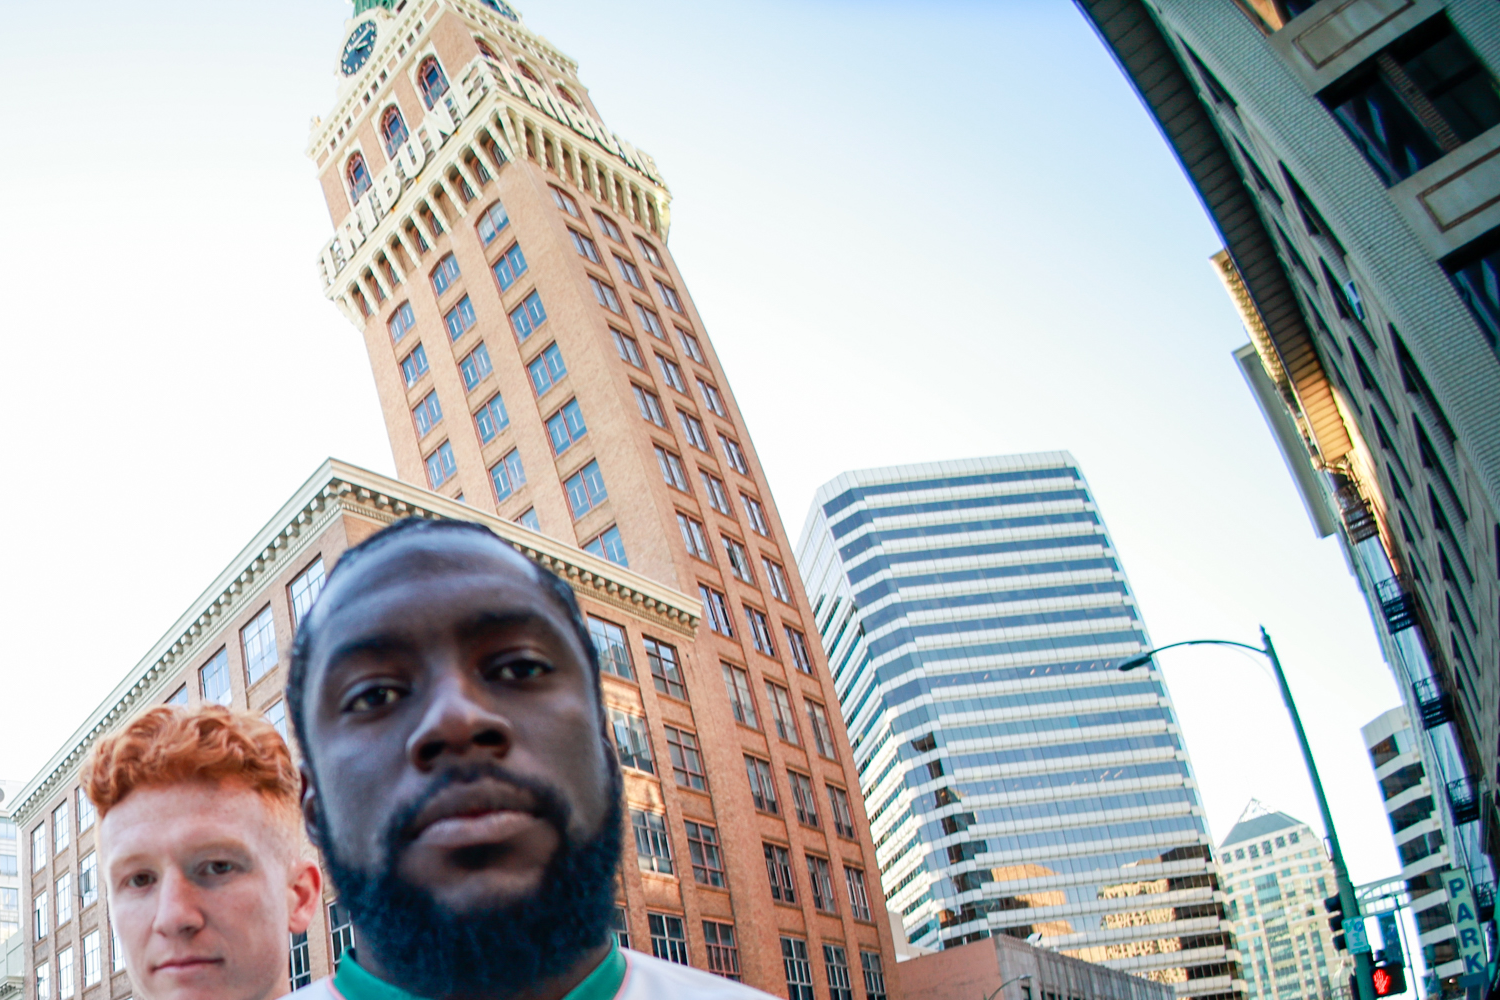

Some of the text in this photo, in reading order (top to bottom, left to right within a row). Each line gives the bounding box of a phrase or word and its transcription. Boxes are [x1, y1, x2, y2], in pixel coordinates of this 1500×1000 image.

[317, 56, 492, 279] TRIBUNE
[485, 57, 666, 188] TRIBUNE
[1448, 877, 1484, 975] PARK
